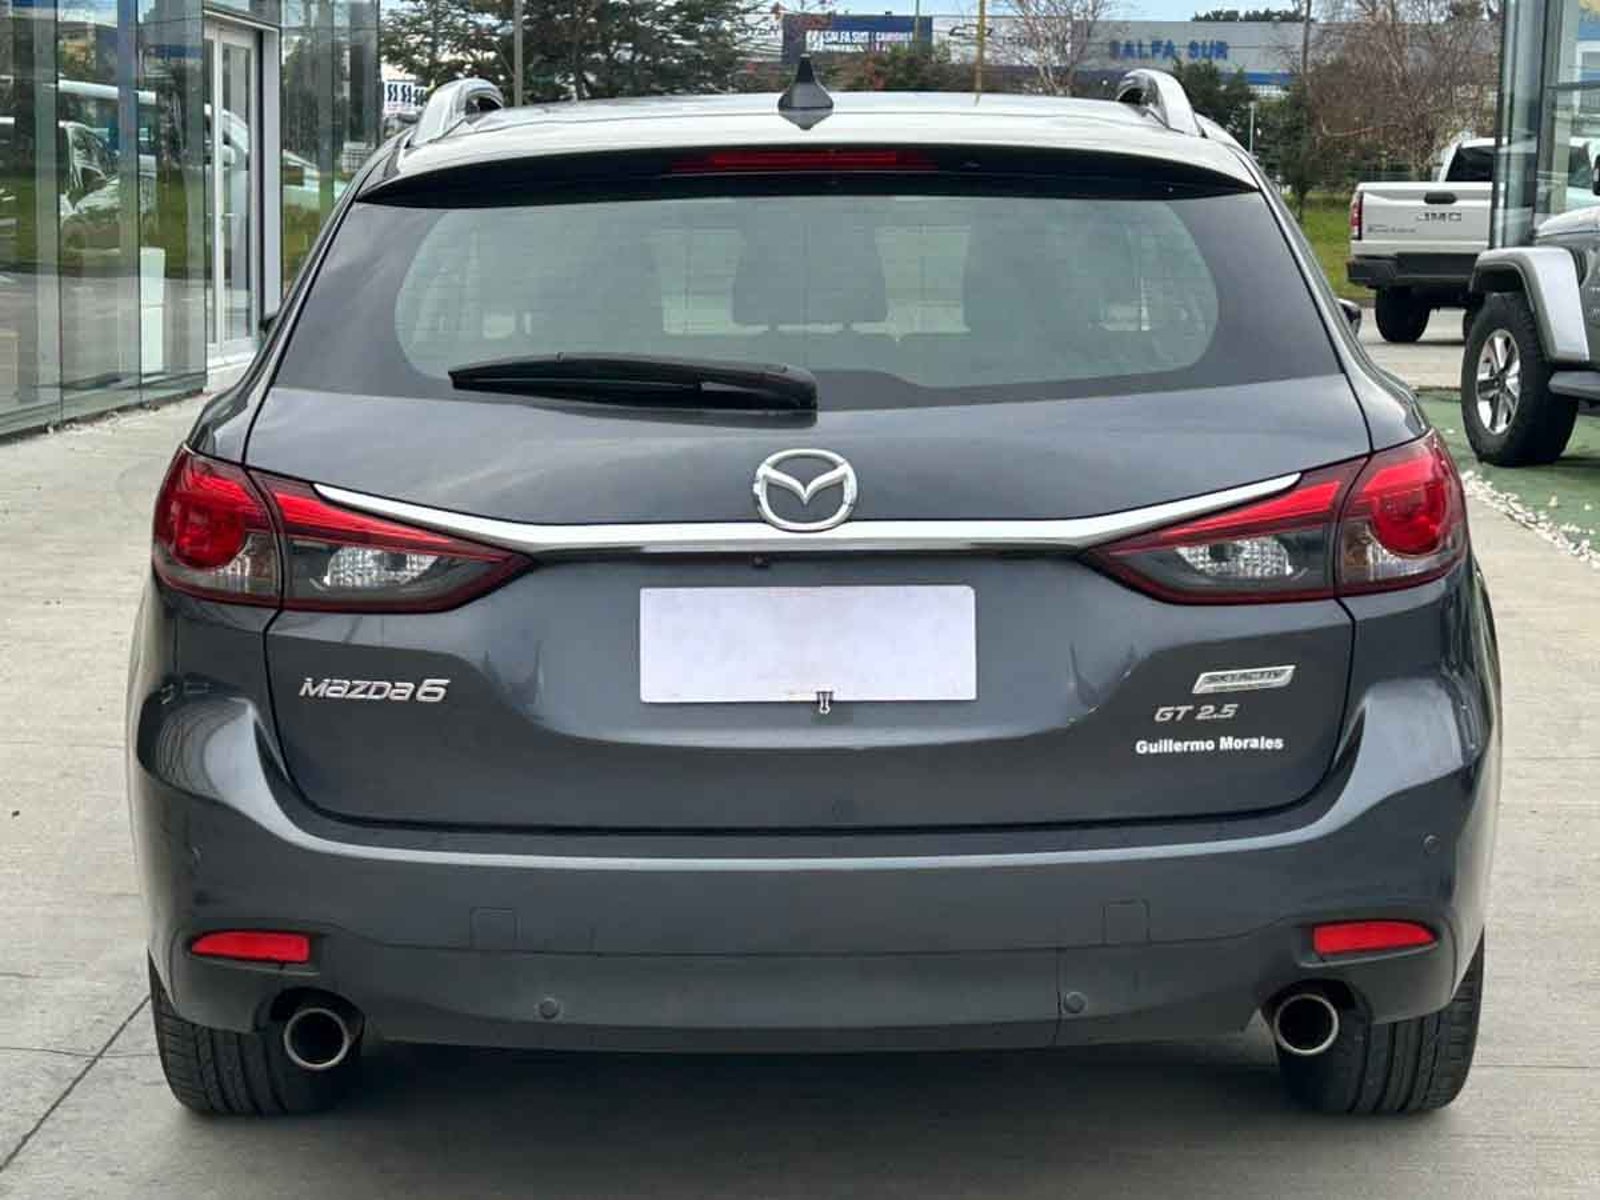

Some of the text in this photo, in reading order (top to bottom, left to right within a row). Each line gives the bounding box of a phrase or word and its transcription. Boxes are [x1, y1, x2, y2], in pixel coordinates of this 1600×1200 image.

[1109, 39, 1228, 60] SALFA SUR
[1154, 703, 1238, 722] GT 2.5
[1135, 735, 1285, 755] Guillermo Morales
